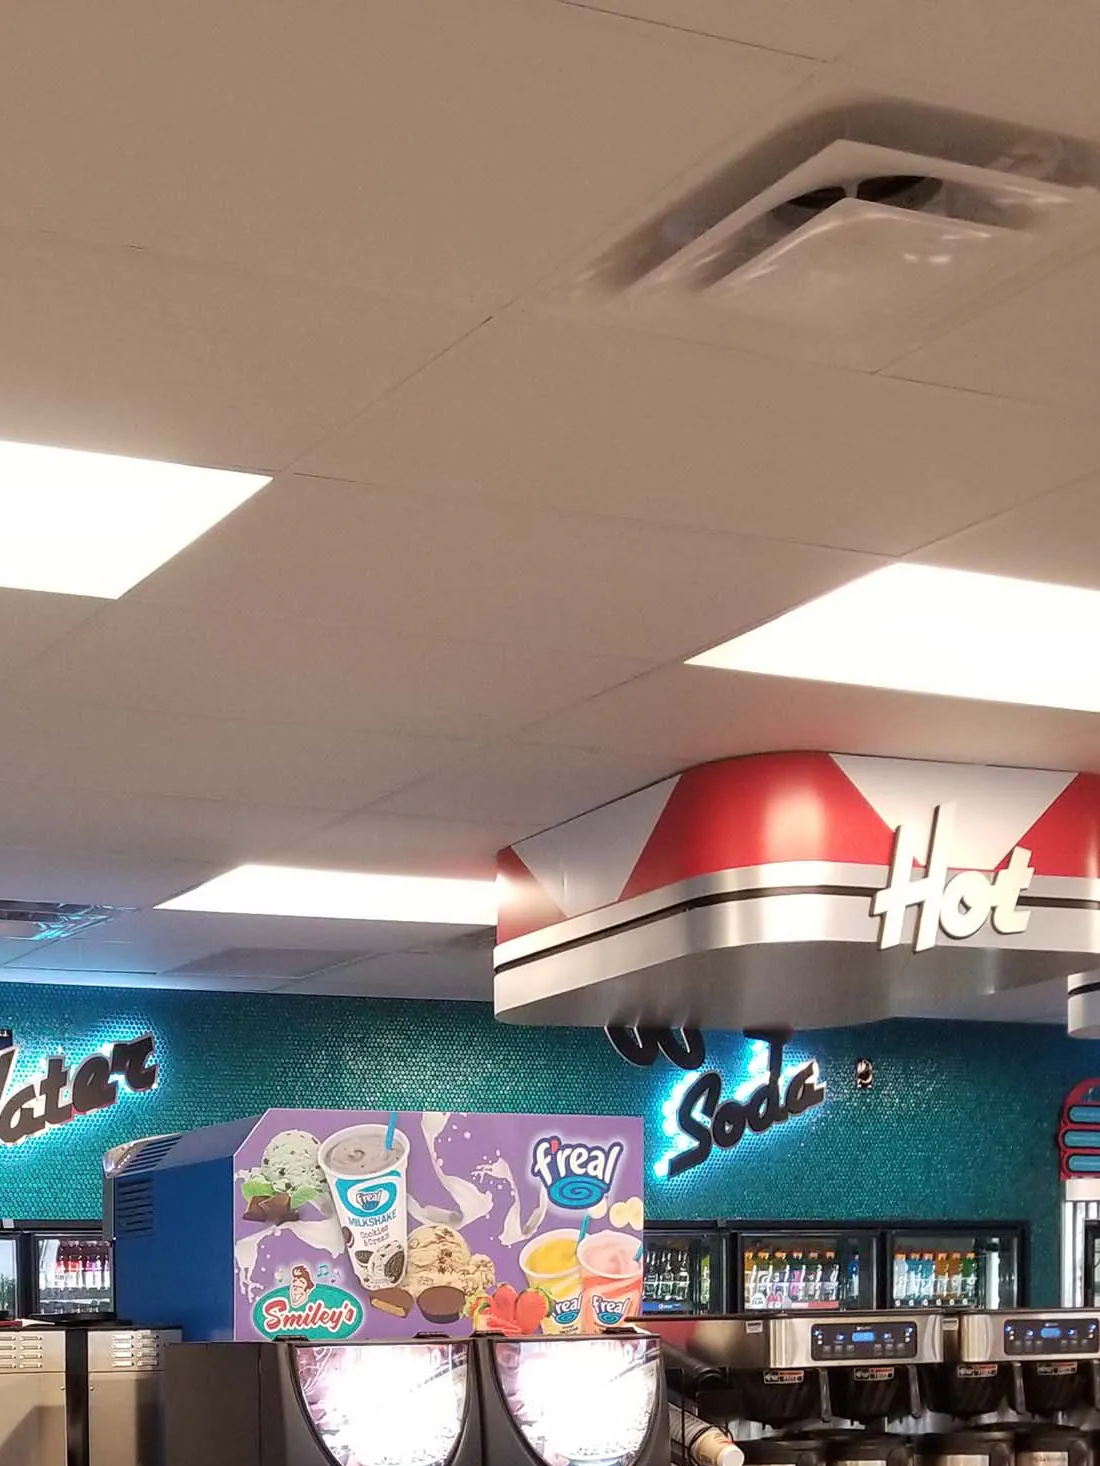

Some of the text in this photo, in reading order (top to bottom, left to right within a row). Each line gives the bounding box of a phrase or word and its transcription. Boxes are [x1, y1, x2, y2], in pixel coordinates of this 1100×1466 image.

[869, 800, 1035, 954] Hot
[667, 1040, 826, 1179] Soda
[532, 1136, 623, 1190] f'real
[348, 1210, 397, 1228] MILKSHAKE
[263, 1297, 357, 1332] Smiley's
